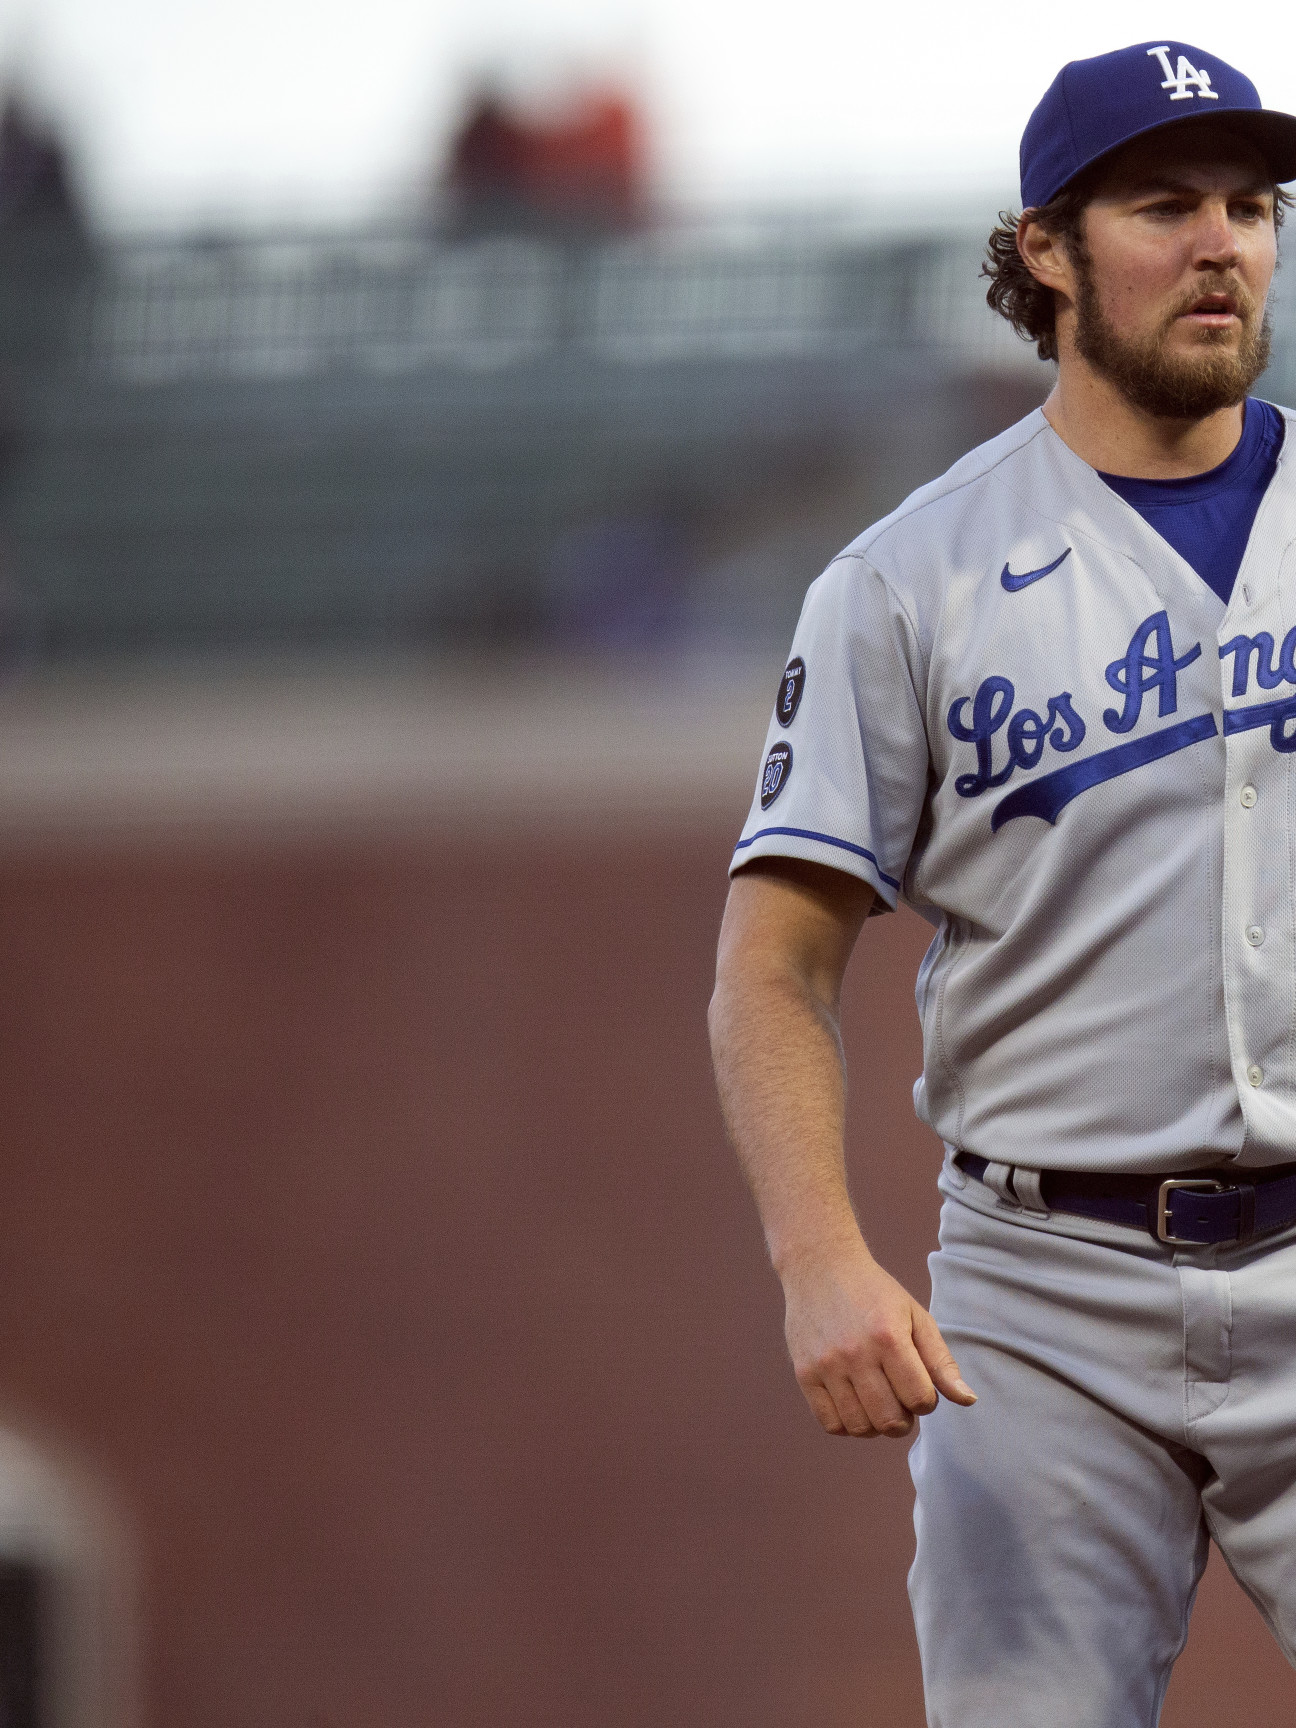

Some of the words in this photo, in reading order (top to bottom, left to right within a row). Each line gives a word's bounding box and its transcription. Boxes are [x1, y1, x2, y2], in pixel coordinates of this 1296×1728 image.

[1146, 45, 1219, 101] LA
[783, 679, 796, 712] 2
[947, 676, 1087, 798] Los
[761, 761, 783, 797] 20
